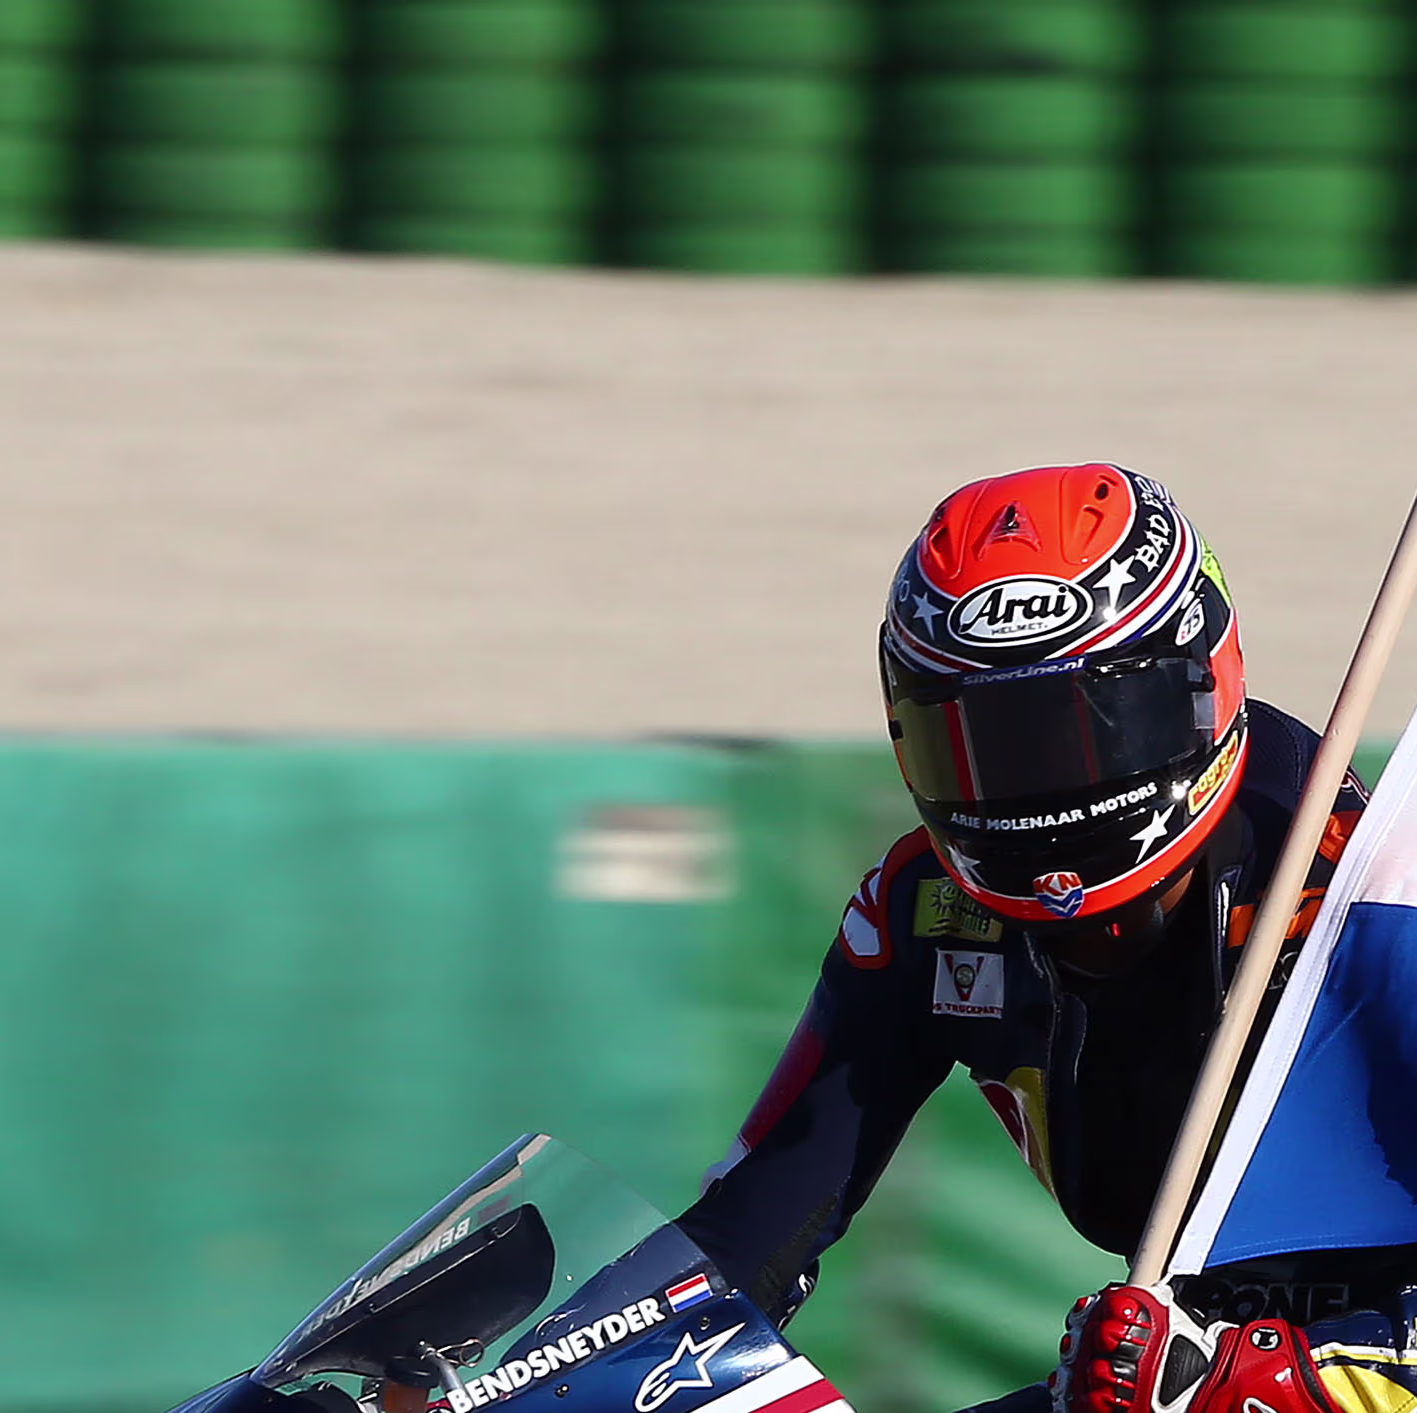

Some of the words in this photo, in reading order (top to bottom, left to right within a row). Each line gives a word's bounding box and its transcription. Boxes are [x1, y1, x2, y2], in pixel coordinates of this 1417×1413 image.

[1135, 514, 1172, 572] BAD
[958, 584, 1072, 634] Arai
[951, 812, 981, 829] ARIE
[986, 809, 1085, 831] MOLENAAR
[1090, 782, 1158, 816] MOTORS
